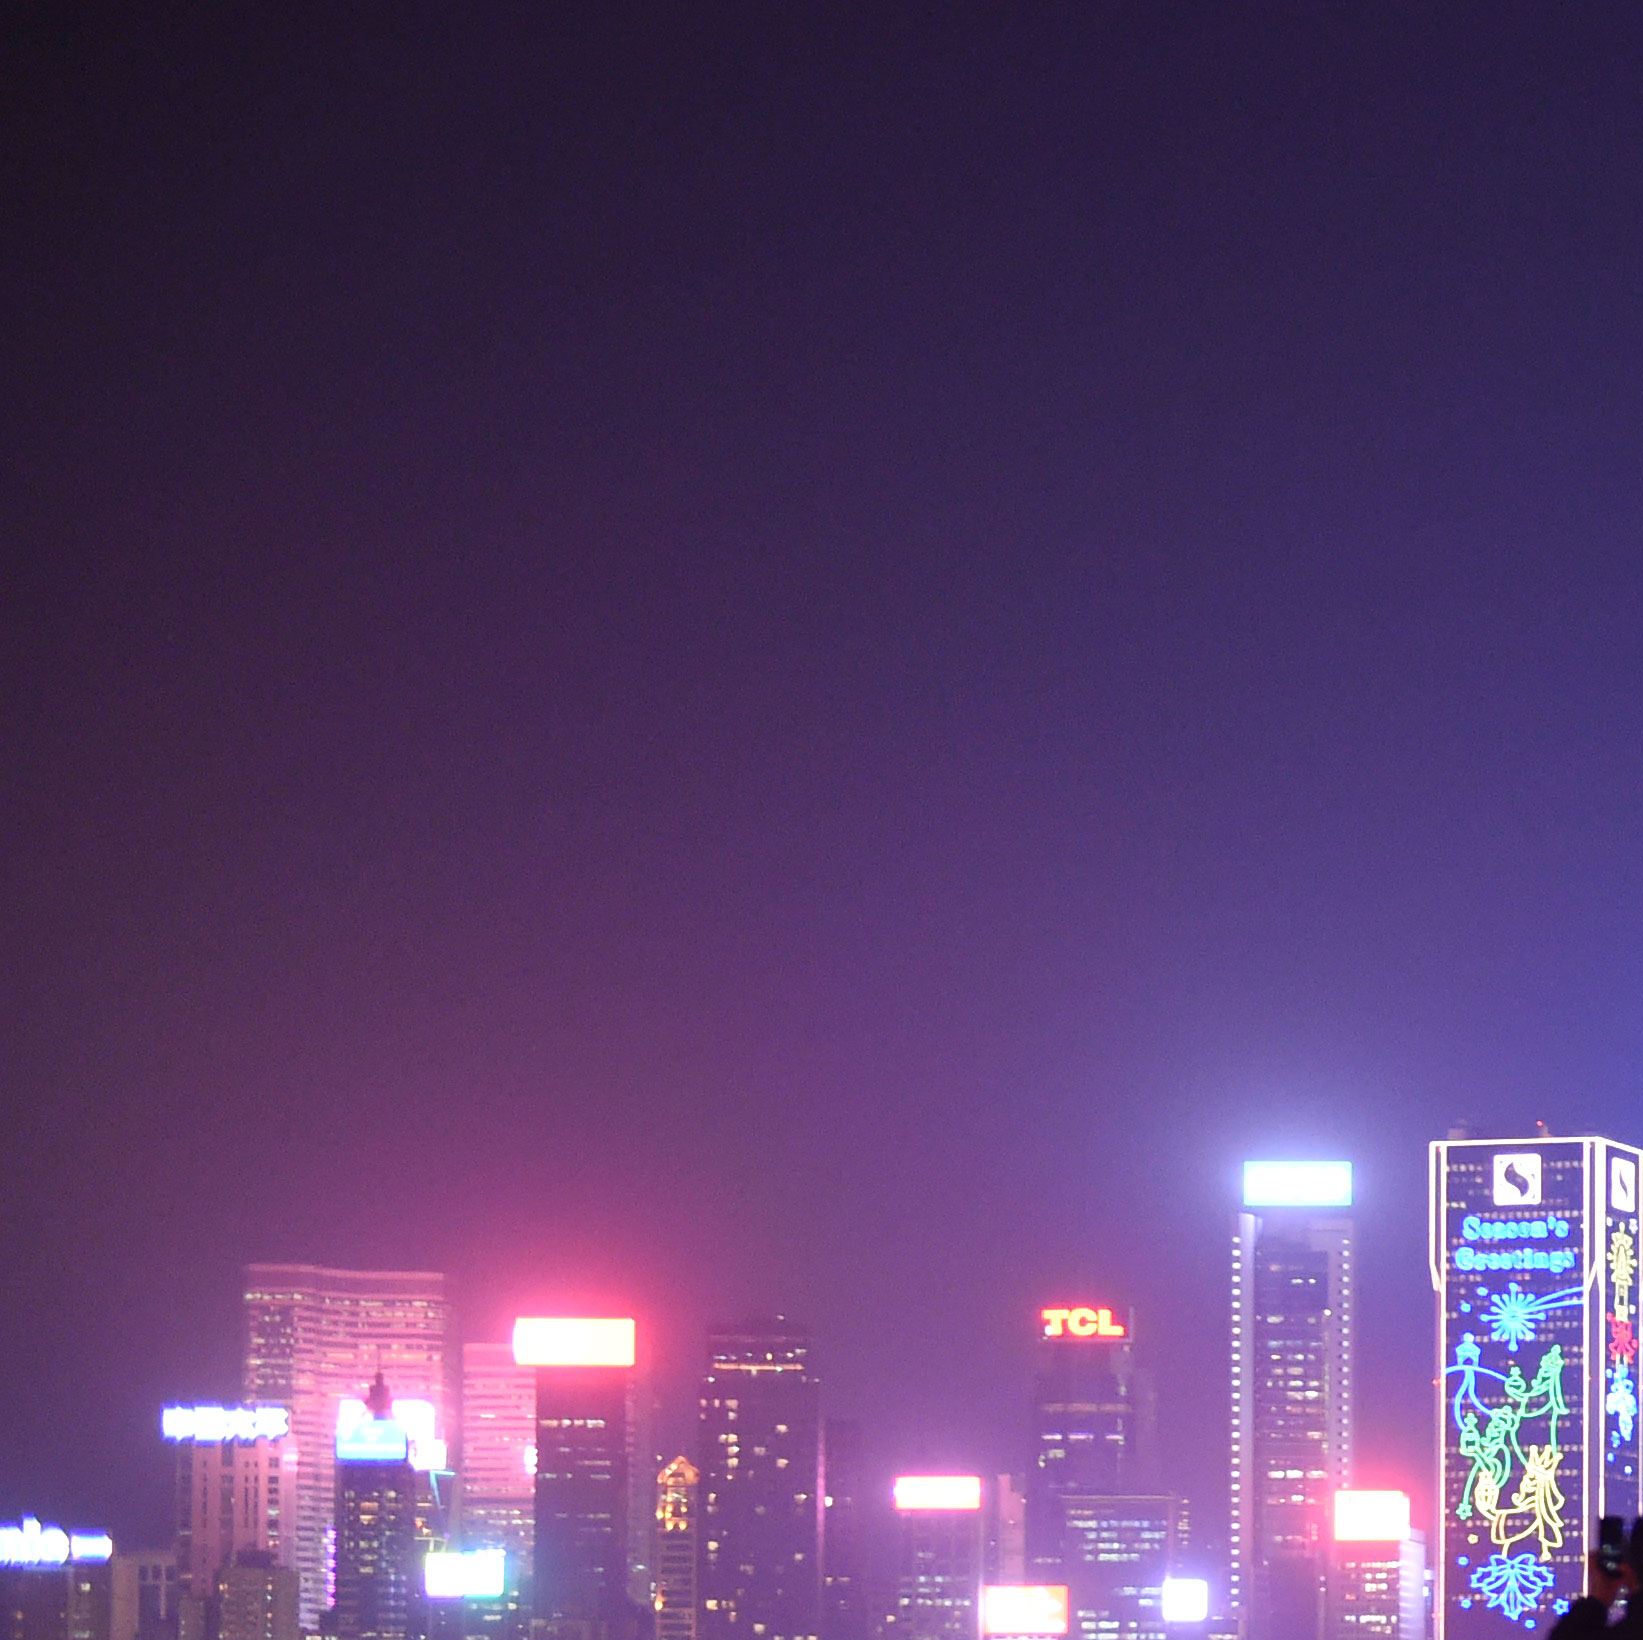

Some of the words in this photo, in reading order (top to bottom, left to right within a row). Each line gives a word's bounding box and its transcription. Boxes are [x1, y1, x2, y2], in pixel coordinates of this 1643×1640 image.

[1462, 1215, 1569, 1240] Season's
[1455, 1246, 1575, 1273] Greetings
[1042, 1307, 1125, 1336] TCL
